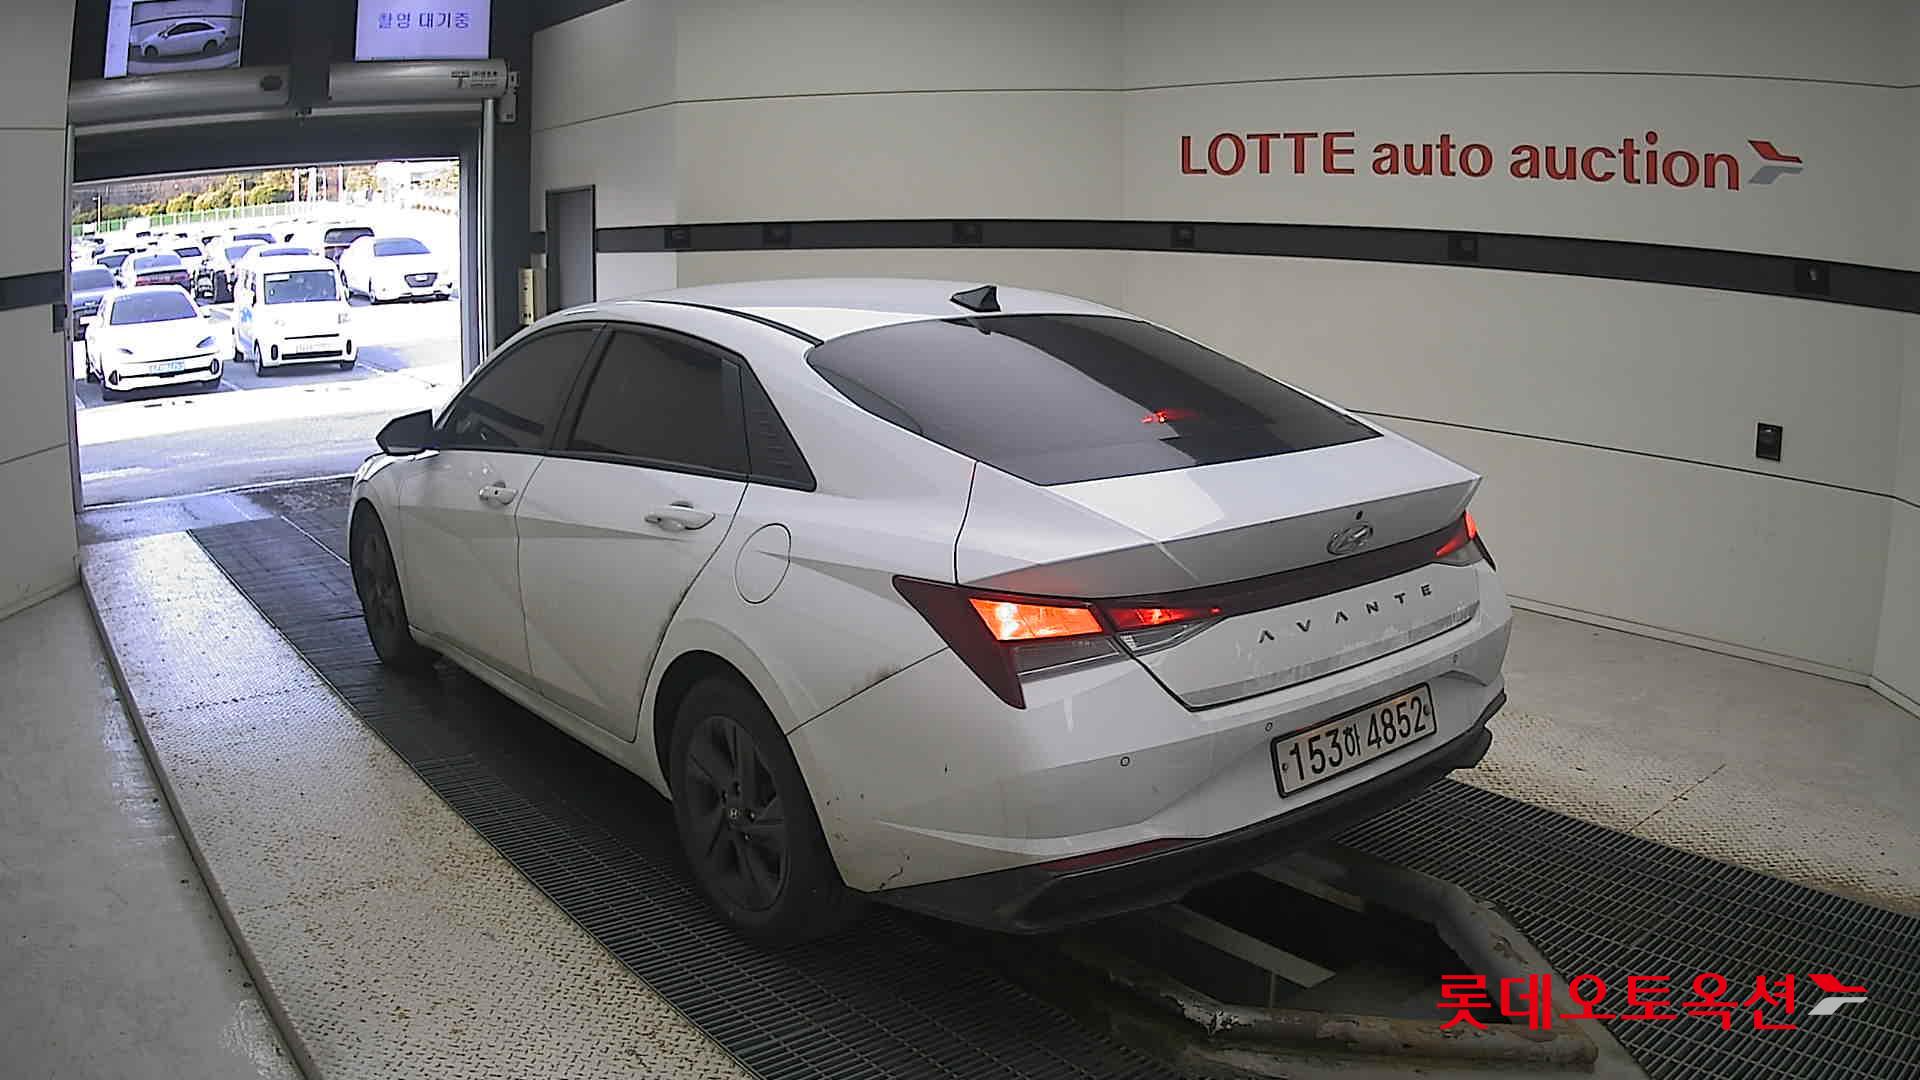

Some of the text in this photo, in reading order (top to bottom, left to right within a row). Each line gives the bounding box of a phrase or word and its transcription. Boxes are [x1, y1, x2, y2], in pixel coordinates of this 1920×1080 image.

[1180, 130, 1741, 191] LOTTE auto auction
[1258, 584, 1433, 644] AVANTE
[1289, 695, 1427, 781] 153하 4852
